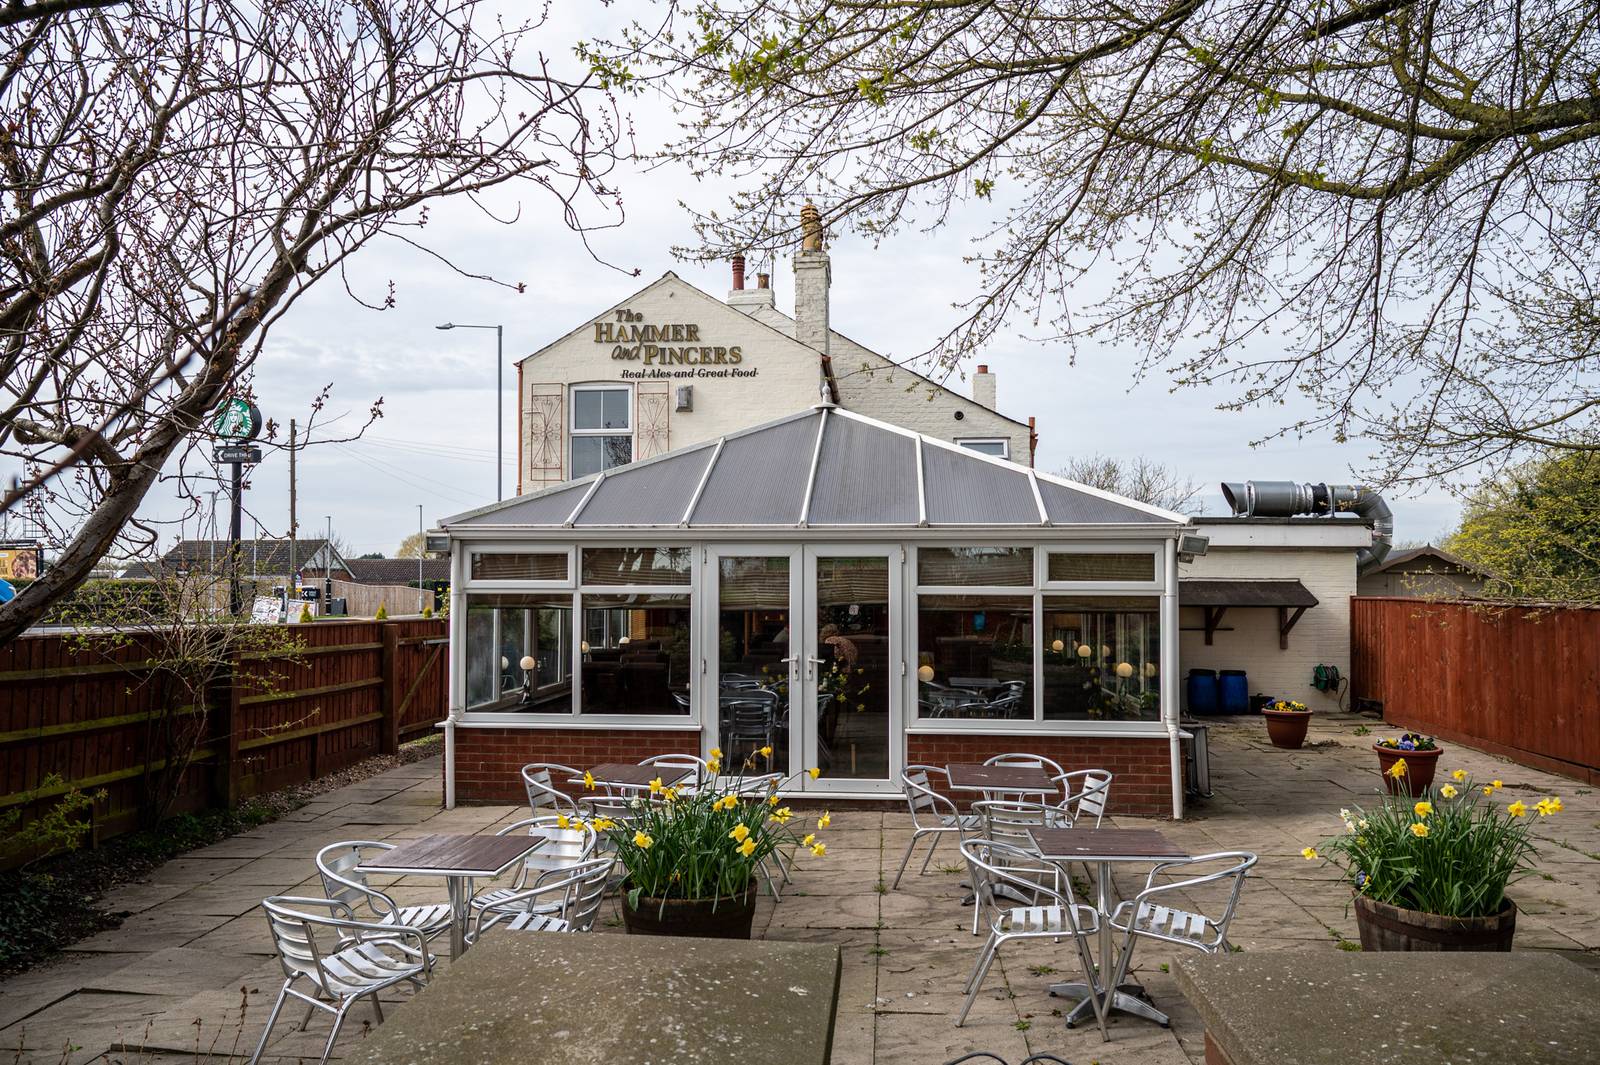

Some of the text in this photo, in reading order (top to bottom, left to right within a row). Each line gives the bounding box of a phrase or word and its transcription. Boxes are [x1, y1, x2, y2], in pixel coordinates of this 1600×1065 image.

[616, 309, 643, 322] The
[594, 322, 701, 343] HAMMER
[643, 344, 743, 365] PINCERS
